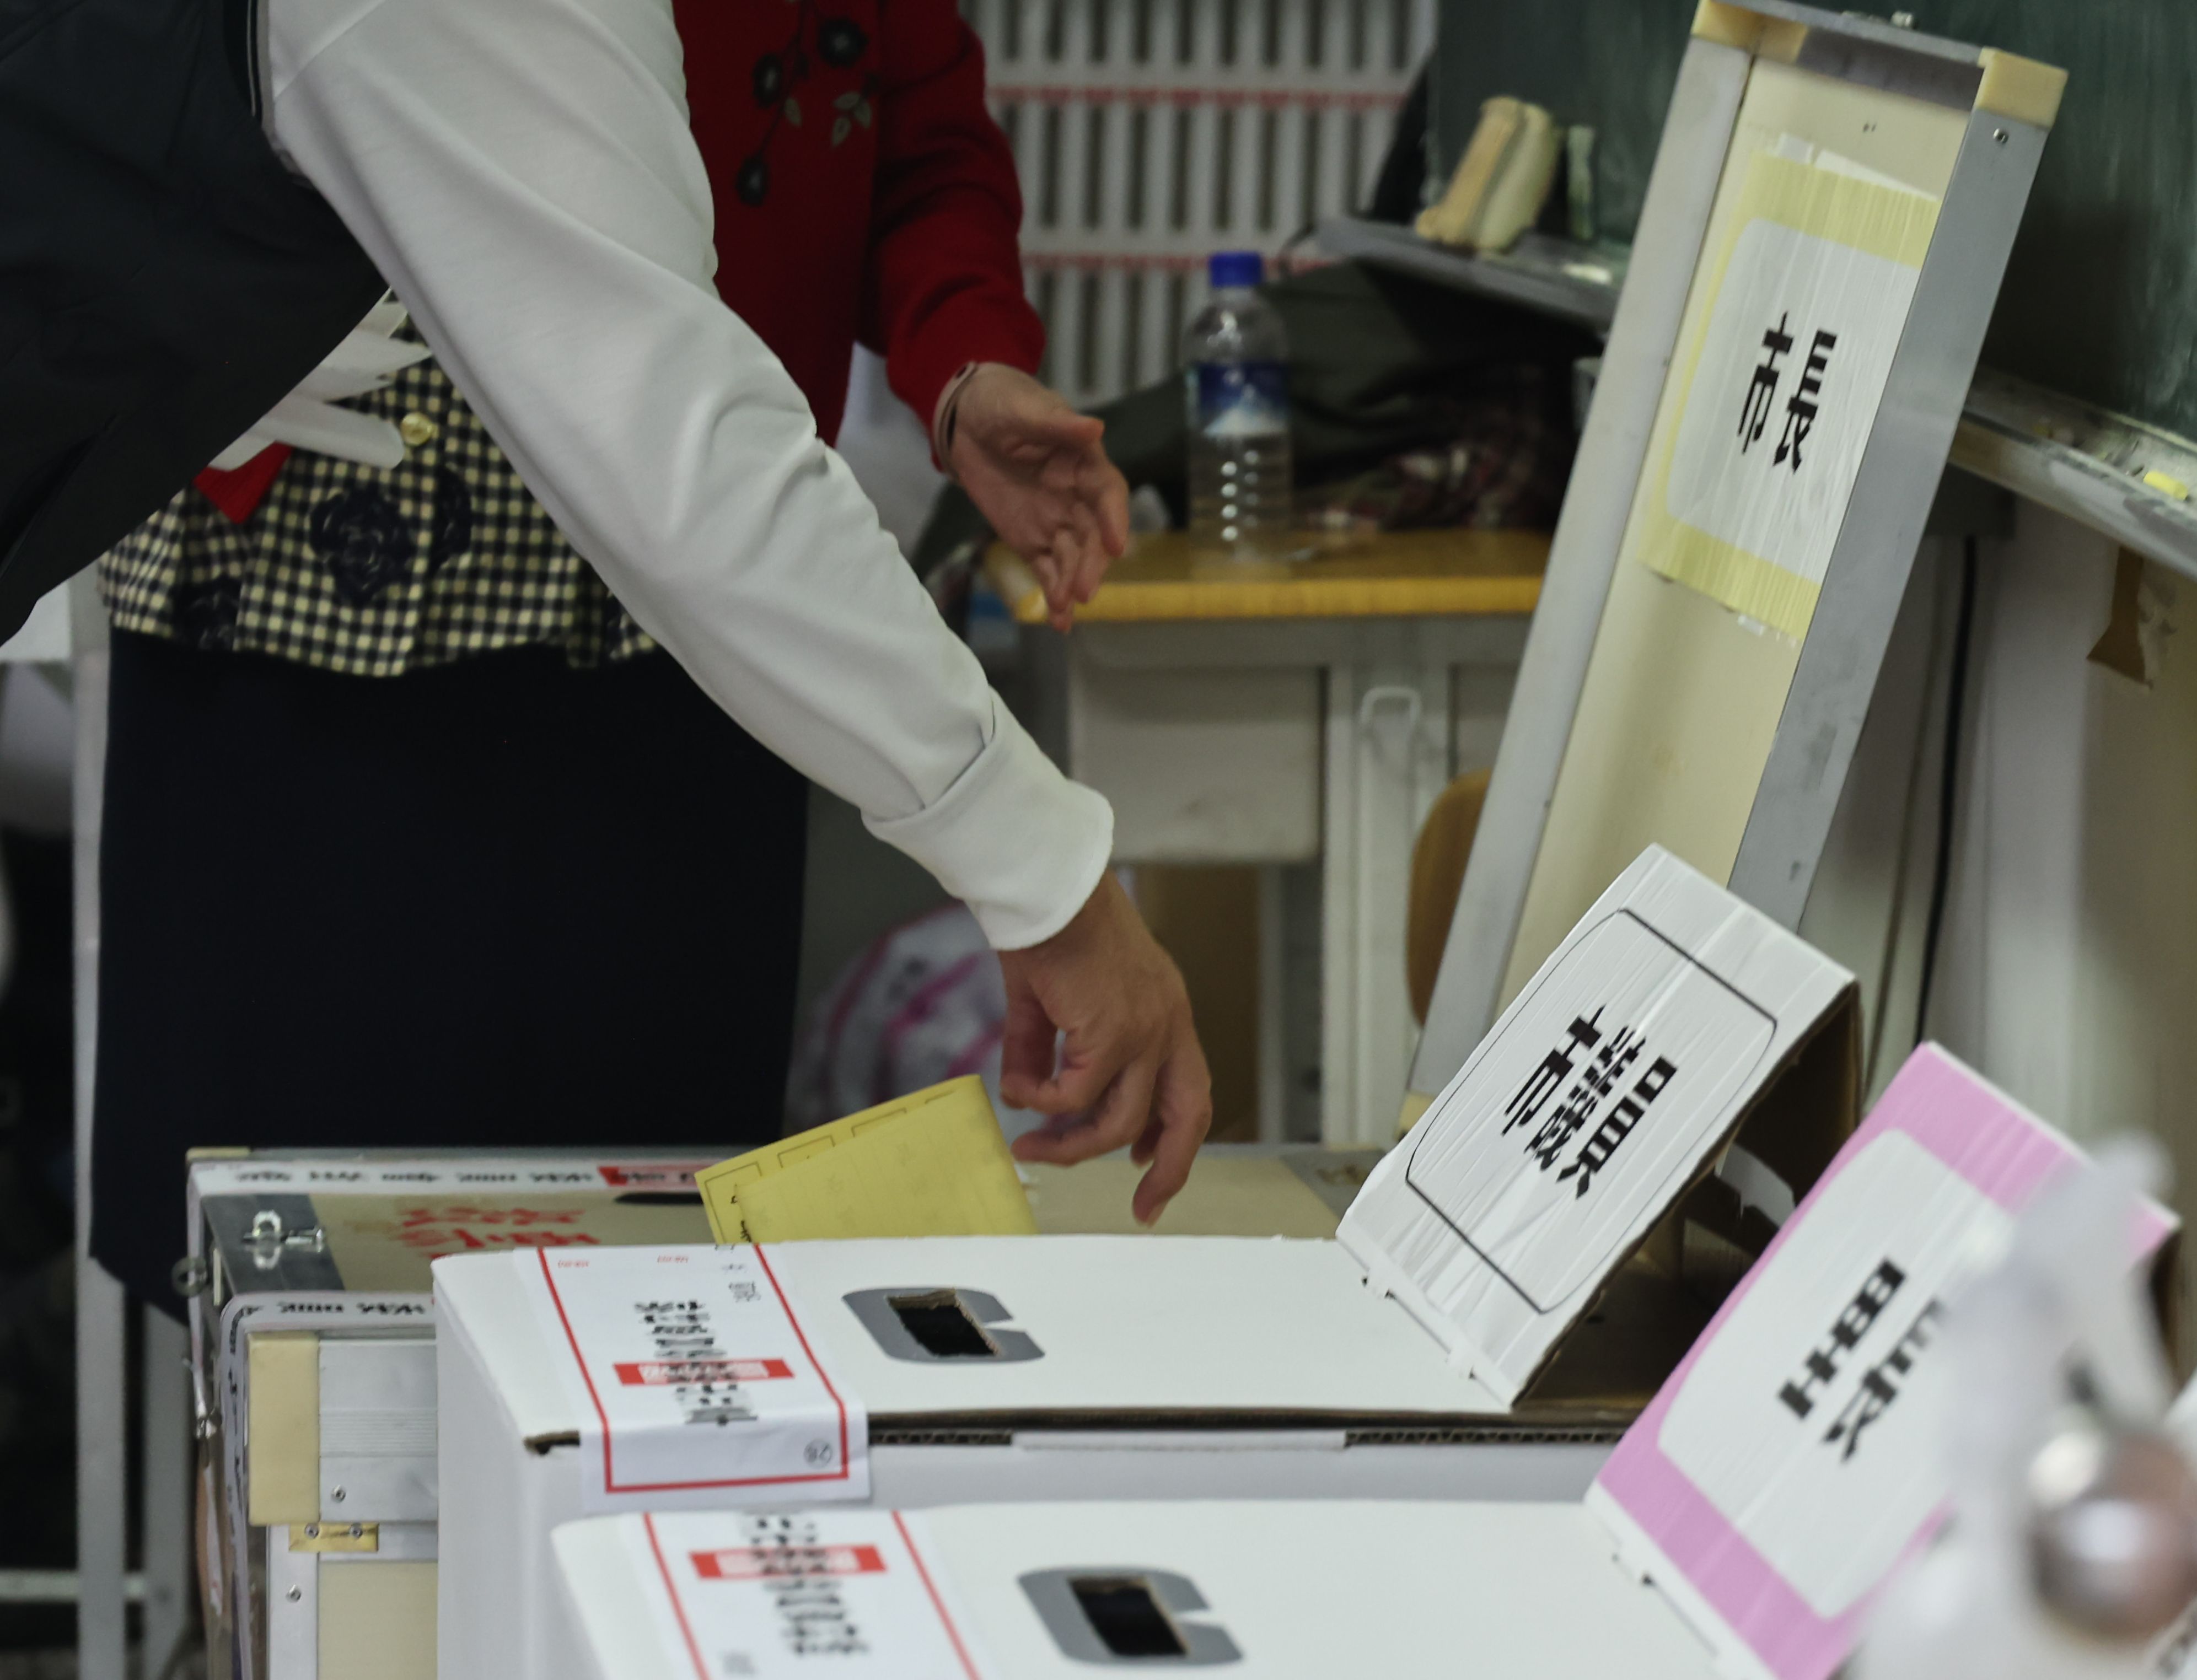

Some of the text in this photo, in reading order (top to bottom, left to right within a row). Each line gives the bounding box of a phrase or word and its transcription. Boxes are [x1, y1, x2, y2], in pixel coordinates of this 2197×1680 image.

[1737, 311, 1838, 475] 市長
[1502, 1003, 1678, 1200] 市議員
[1777, 1257, 1946, 1463] 里長
